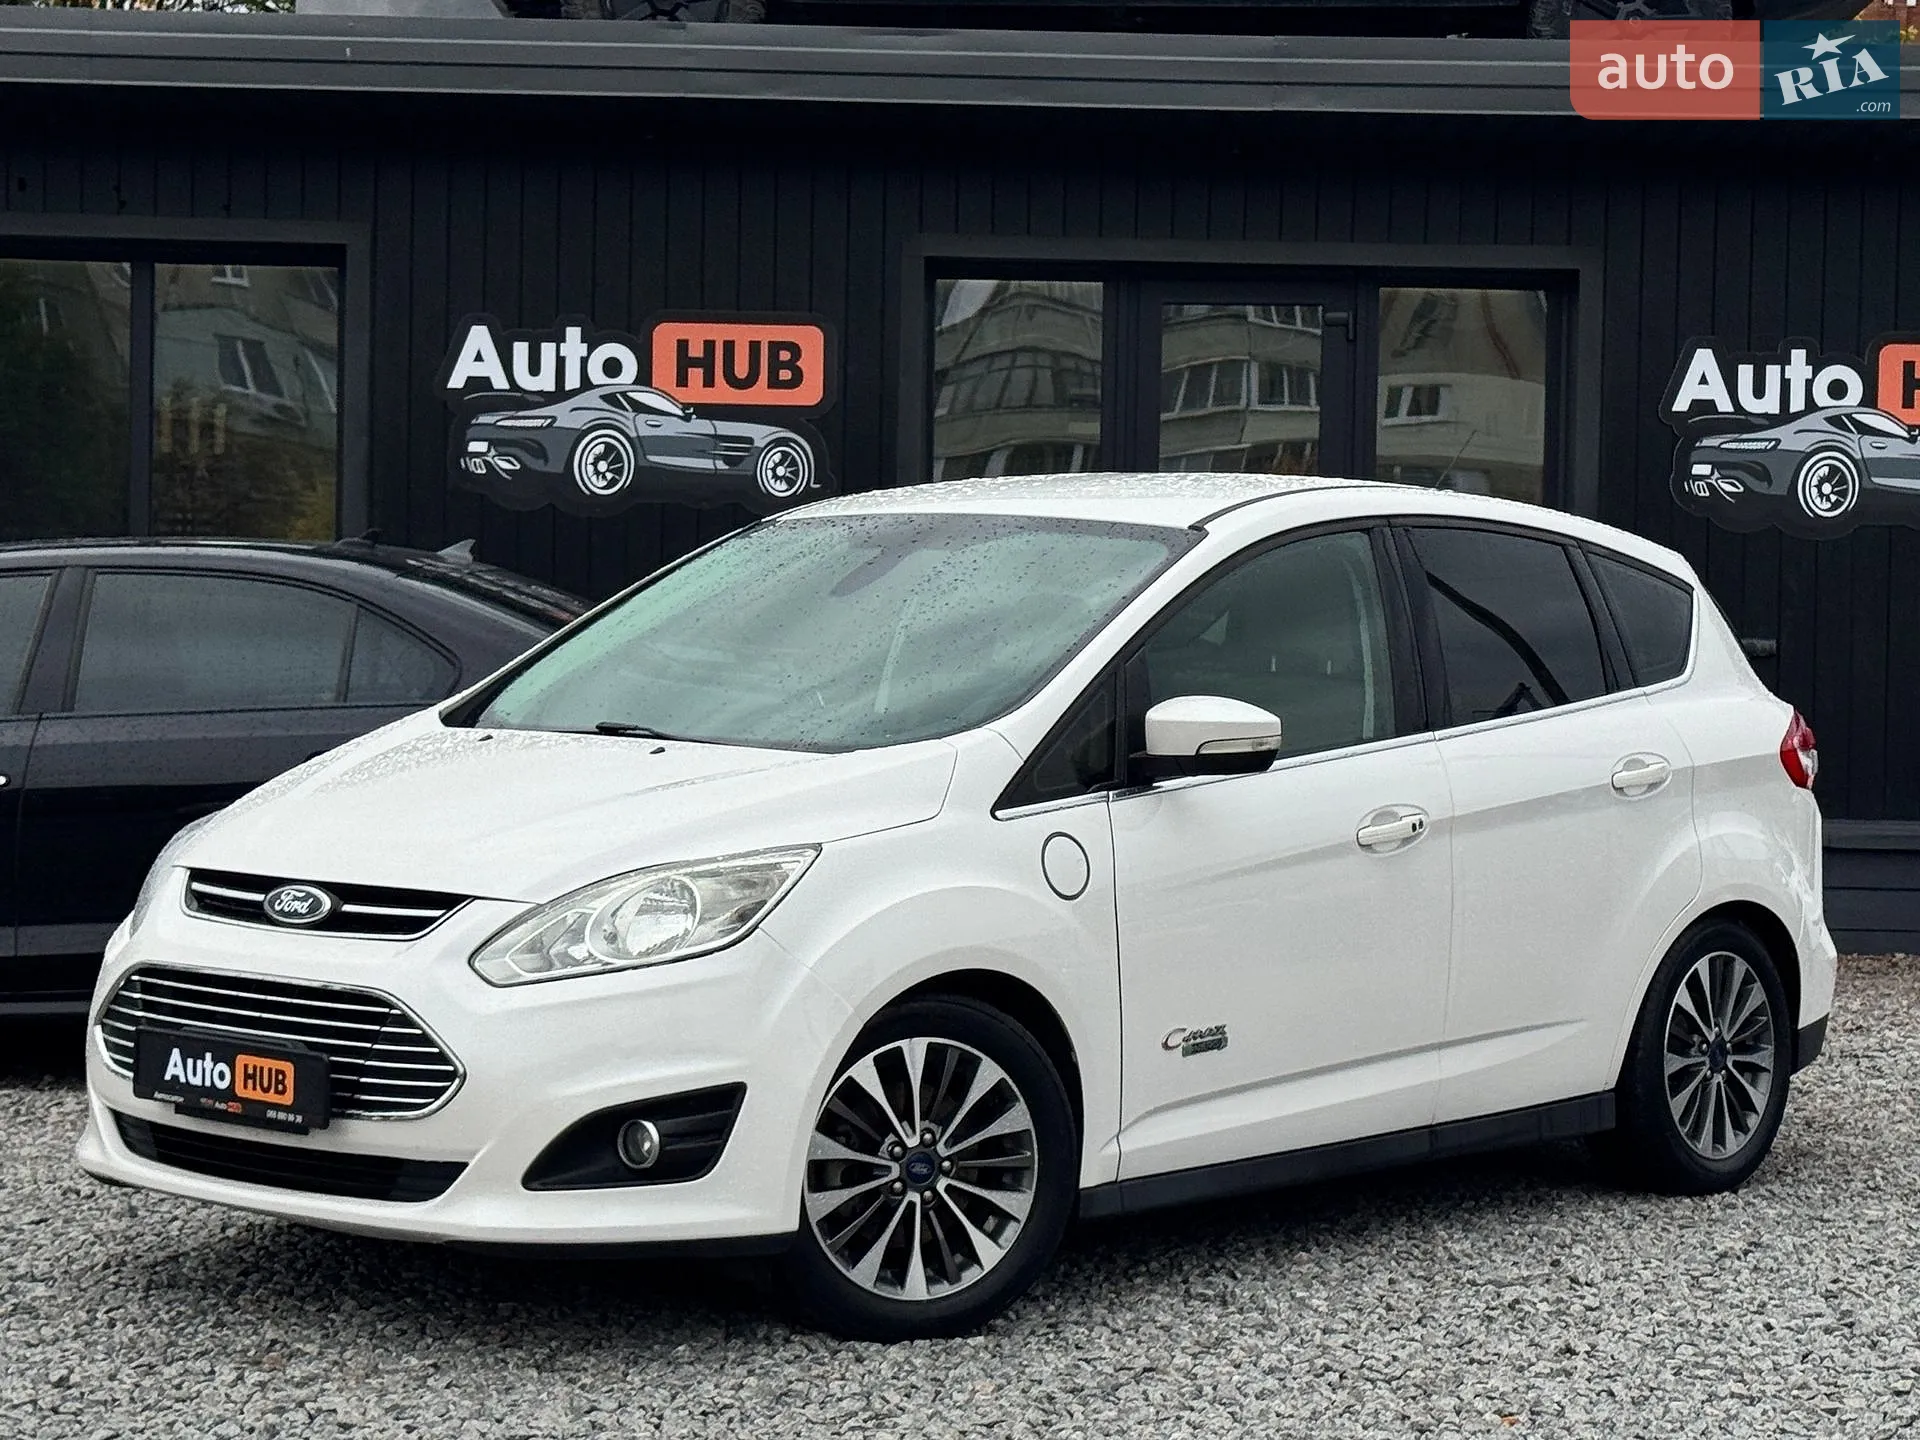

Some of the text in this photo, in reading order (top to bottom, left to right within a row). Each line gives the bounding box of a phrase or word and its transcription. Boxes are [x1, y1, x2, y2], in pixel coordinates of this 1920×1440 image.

[446, 324, 805, 393] Auto HUB
[1671, 347, 1865, 415] Auto
[274, 889, 314, 914] Ford
[164, 1047, 289, 1097] Auto HUB
